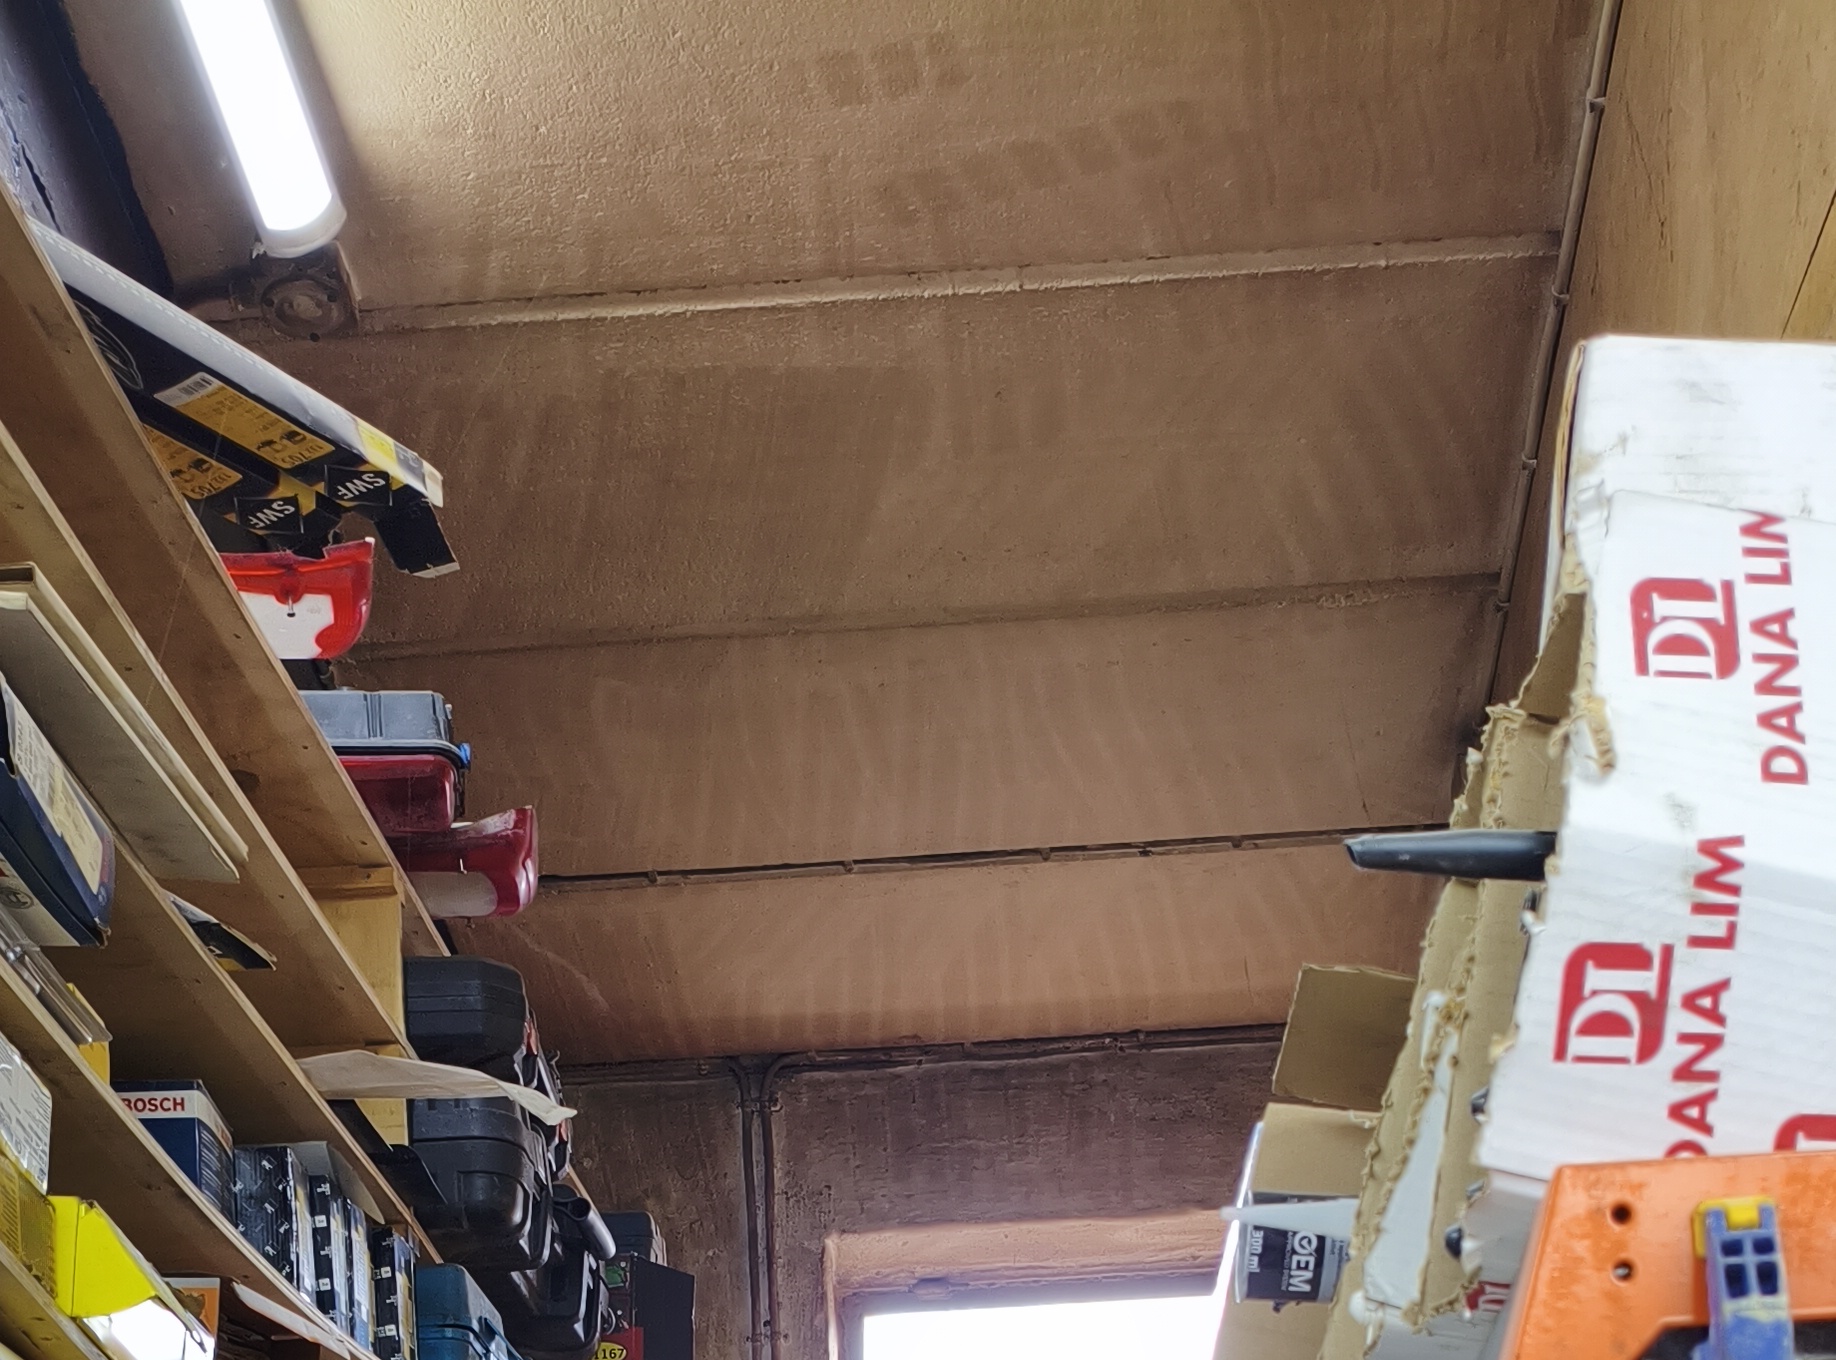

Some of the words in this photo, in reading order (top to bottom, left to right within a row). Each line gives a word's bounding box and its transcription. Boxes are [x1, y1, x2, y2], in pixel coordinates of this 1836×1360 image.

[337, 472, 386, 501] SWF
[249, 500, 296, 530] SWF
[1749, 607, 1809, 785] DANA
[1686, 835, 1745, 950] LIM
[120, 1096, 186, 1113] BOSCH
